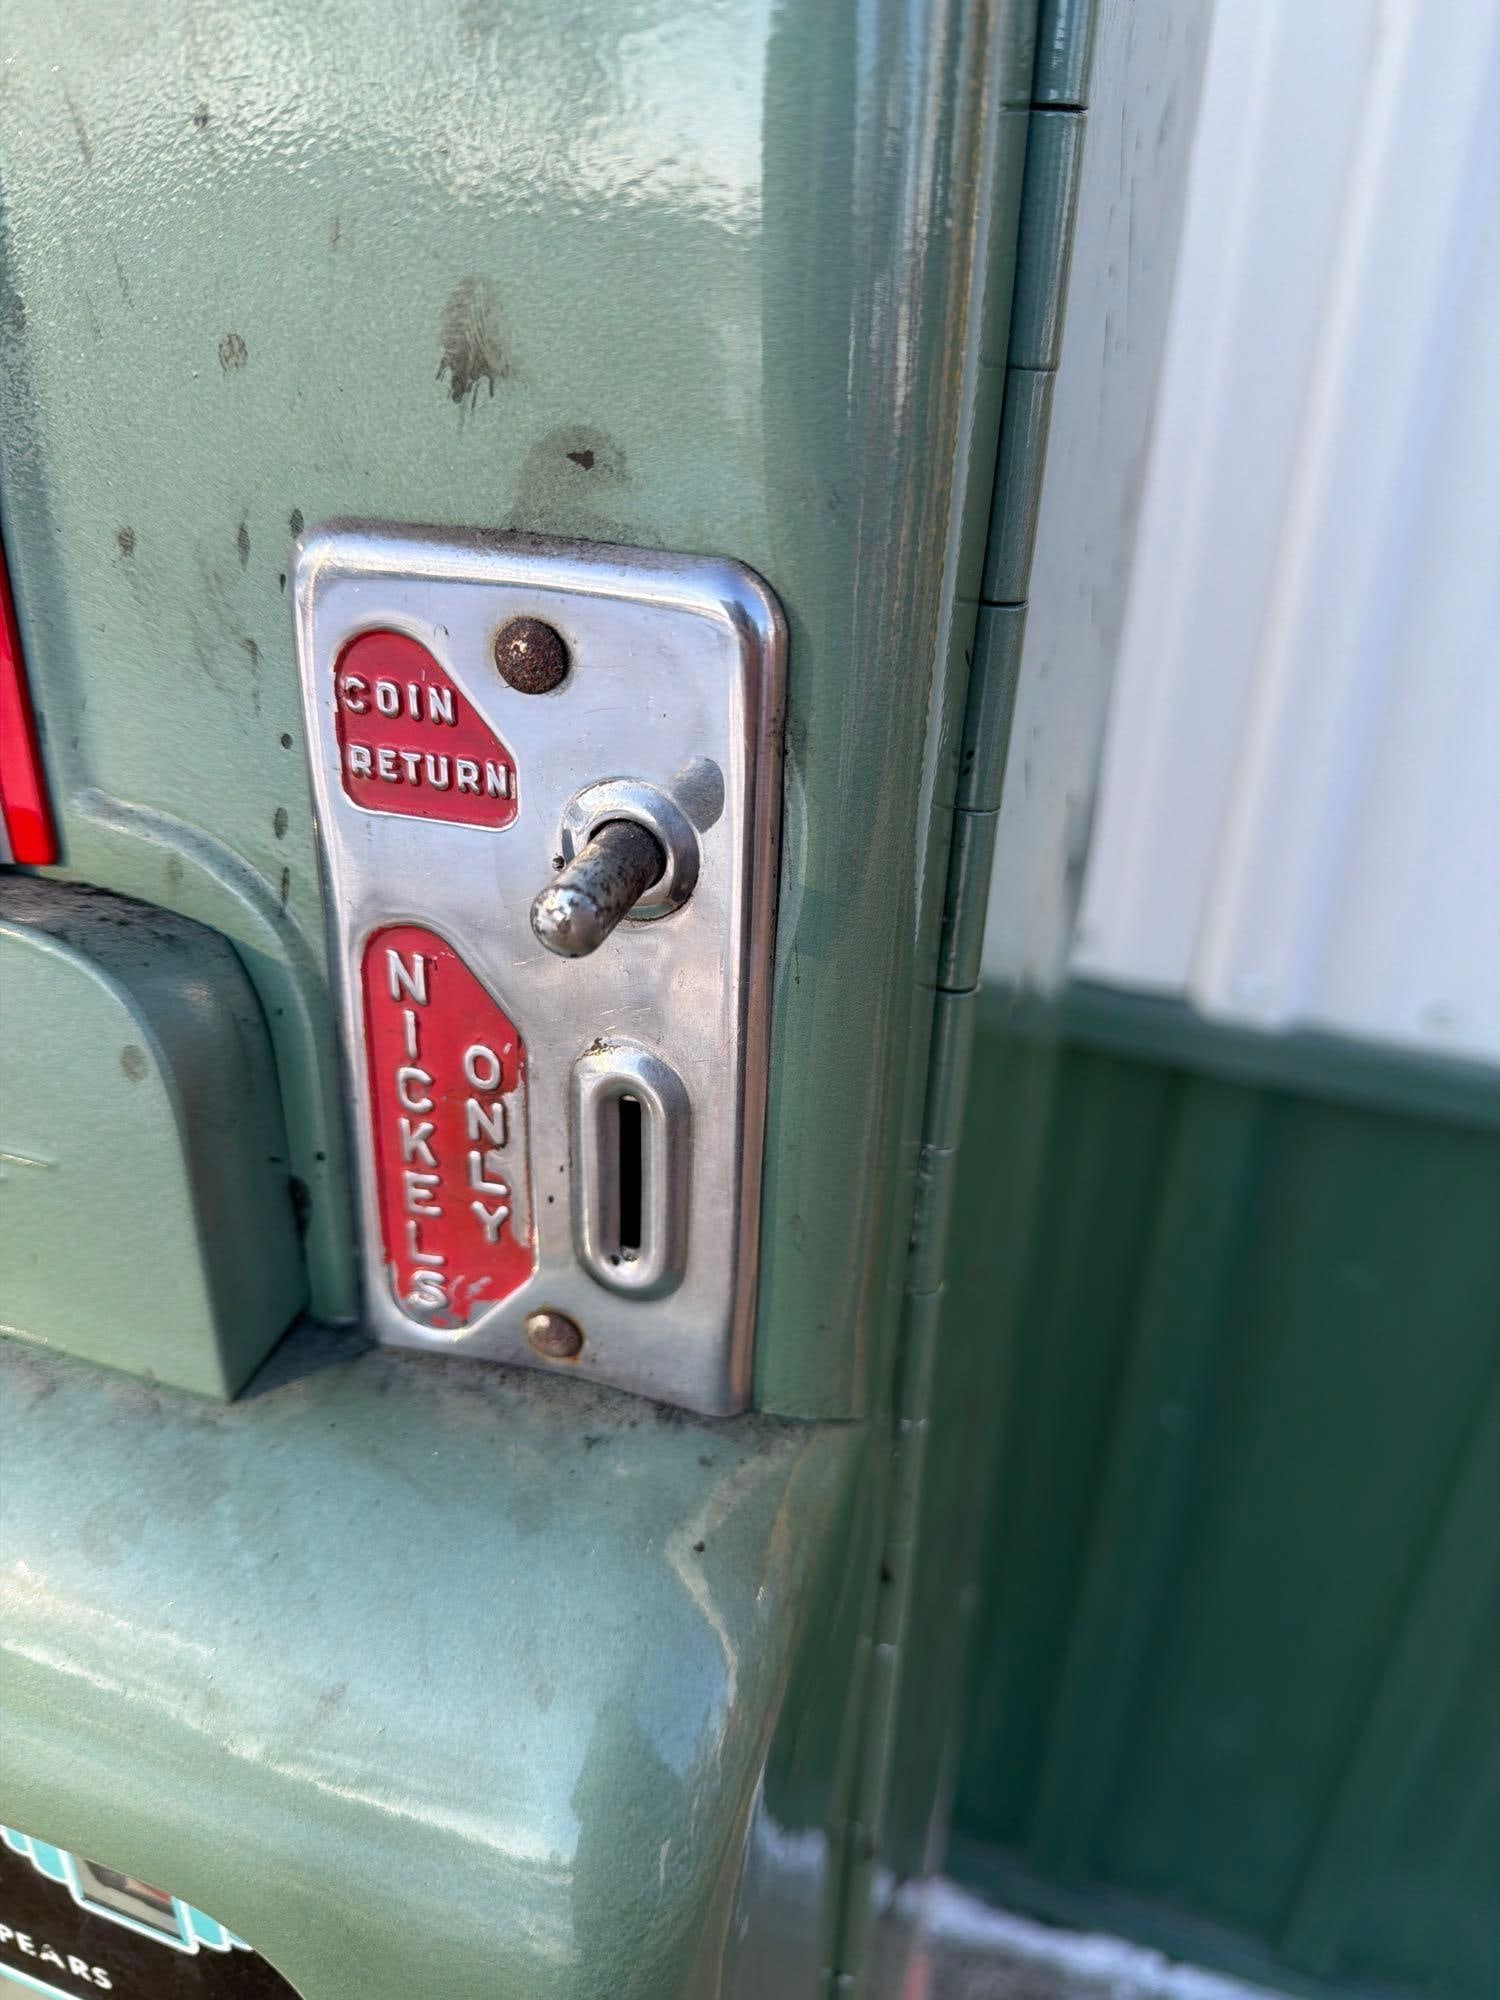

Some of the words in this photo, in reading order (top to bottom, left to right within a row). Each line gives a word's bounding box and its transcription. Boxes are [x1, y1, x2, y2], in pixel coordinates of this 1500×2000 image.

[341, 676, 457, 725] COIN
[349, 744, 511, 799] RETURN
[386, 949, 449, 1310] NICKELS
[464, 1044, 509, 1243] ONLY
